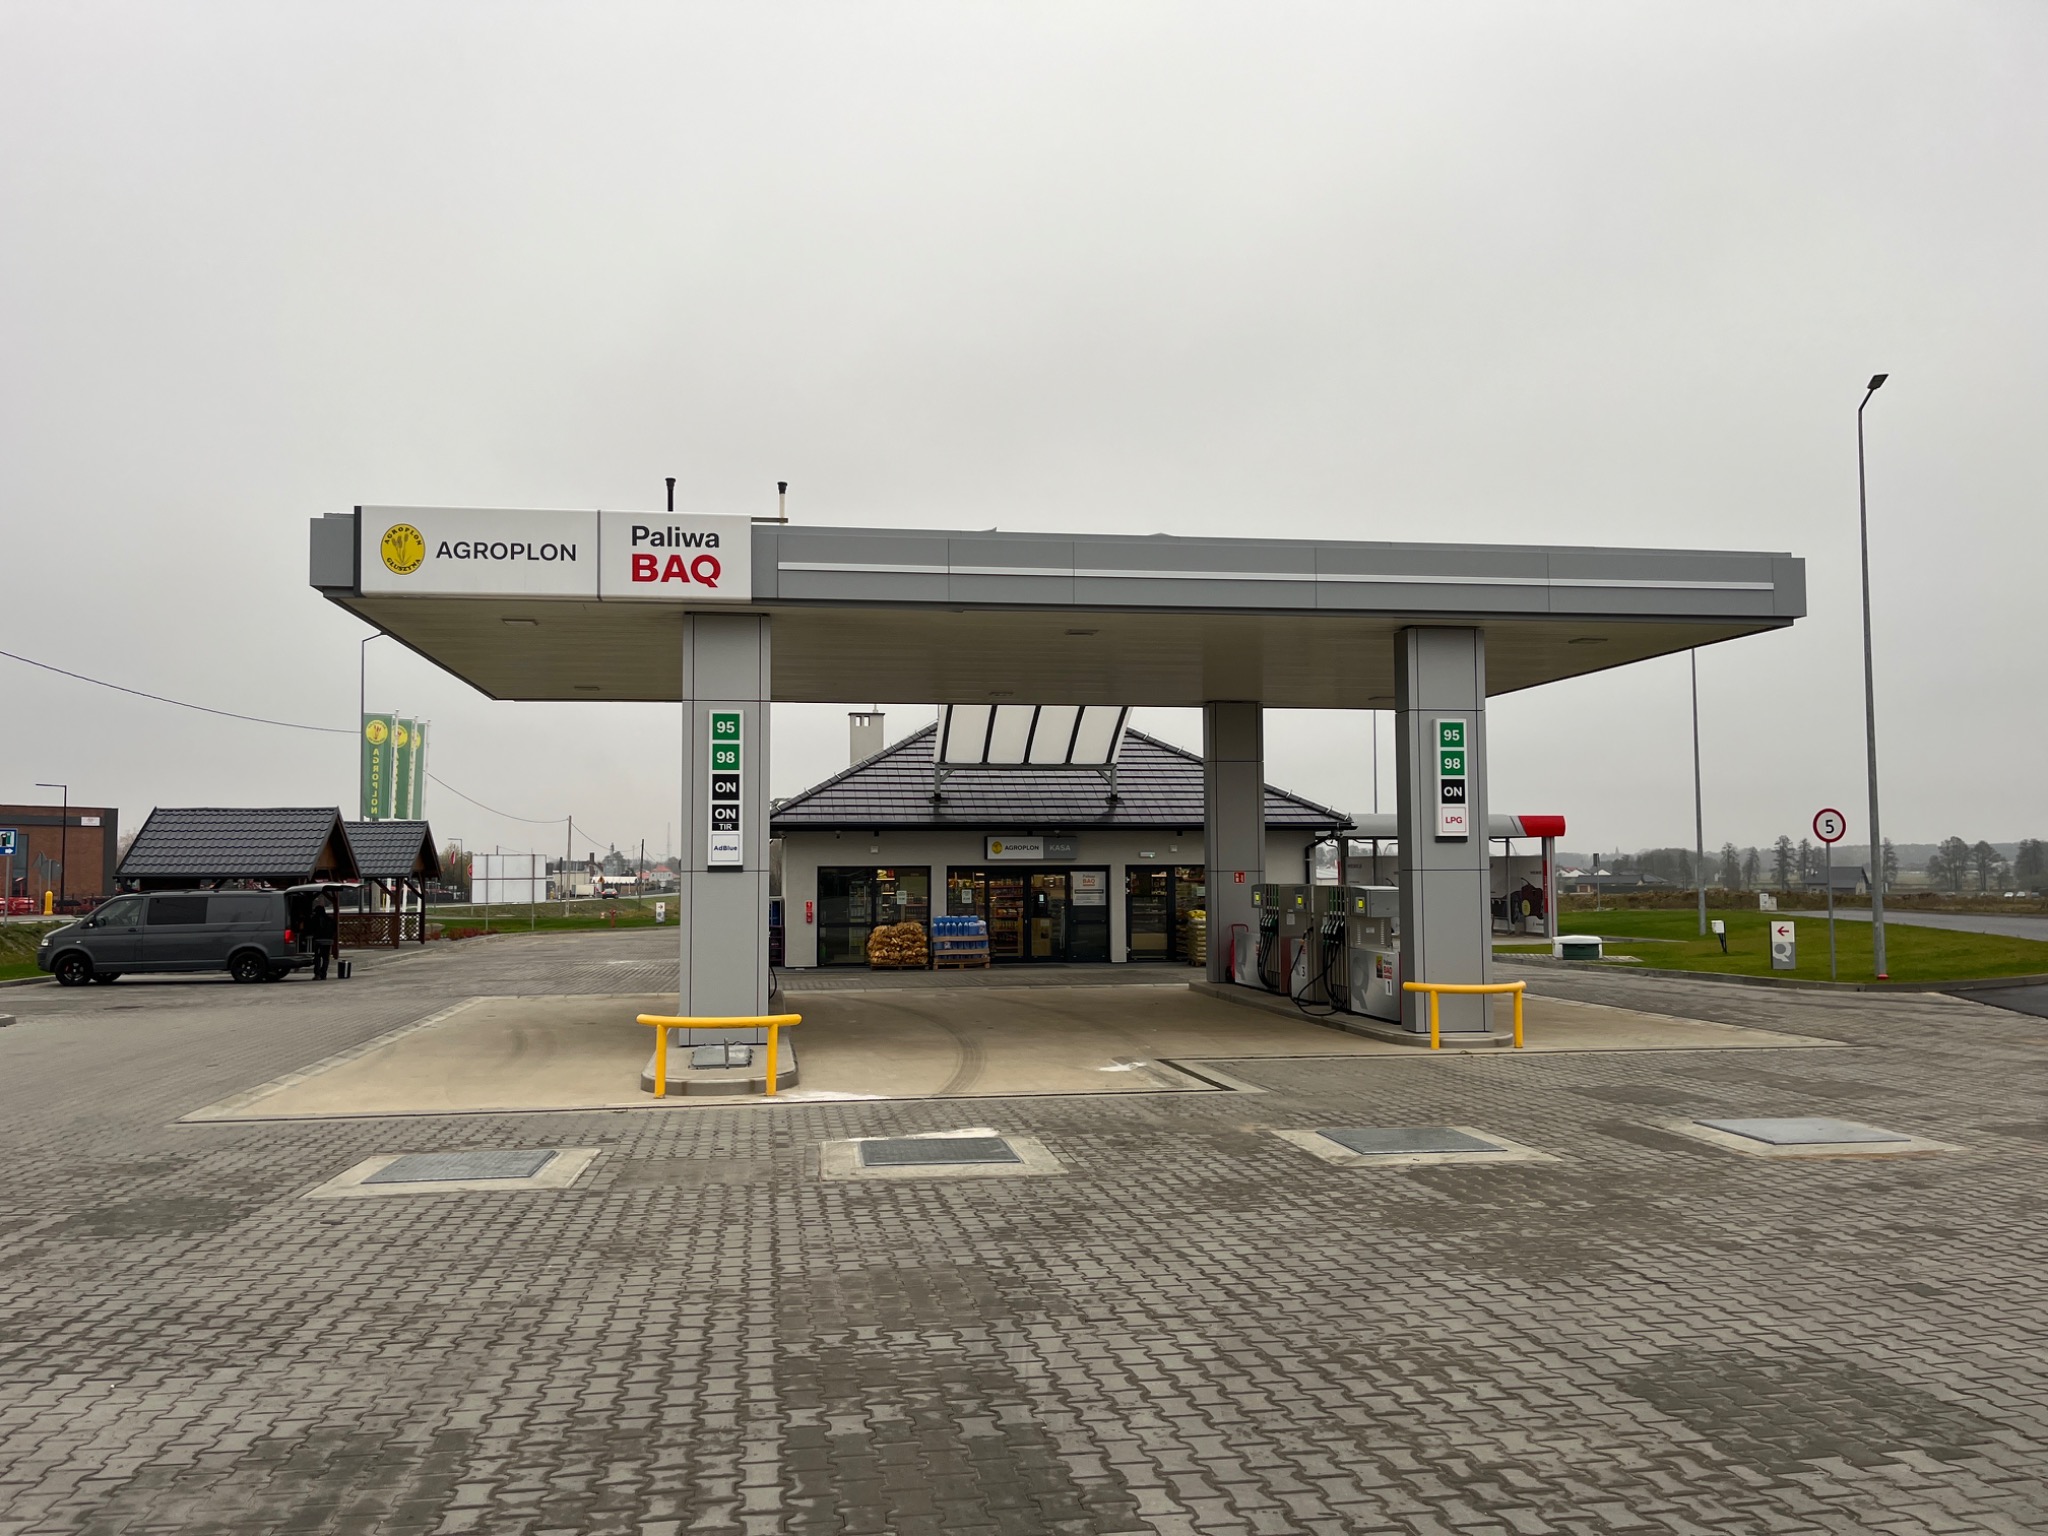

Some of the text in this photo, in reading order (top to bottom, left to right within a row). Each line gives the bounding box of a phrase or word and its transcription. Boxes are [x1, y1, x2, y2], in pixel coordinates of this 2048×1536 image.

[631, 525, 720, 548] Paliwa
[436, 541, 577, 562] AGROPLON
[631, 553, 721, 588] BAQ
[716, 721, 735, 733] 95
[1443, 729, 1460, 741] 95
[716, 751, 735, 763] 98
[1444, 758, 1461, 769] 98
[715, 782, 736, 793] ON
[1443, 786, 1463, 797] ON
[715, 808, 736, 819] ON
[1445, 816, 1463, 824] LPG
[1825, 819, 1835, 834] 5
